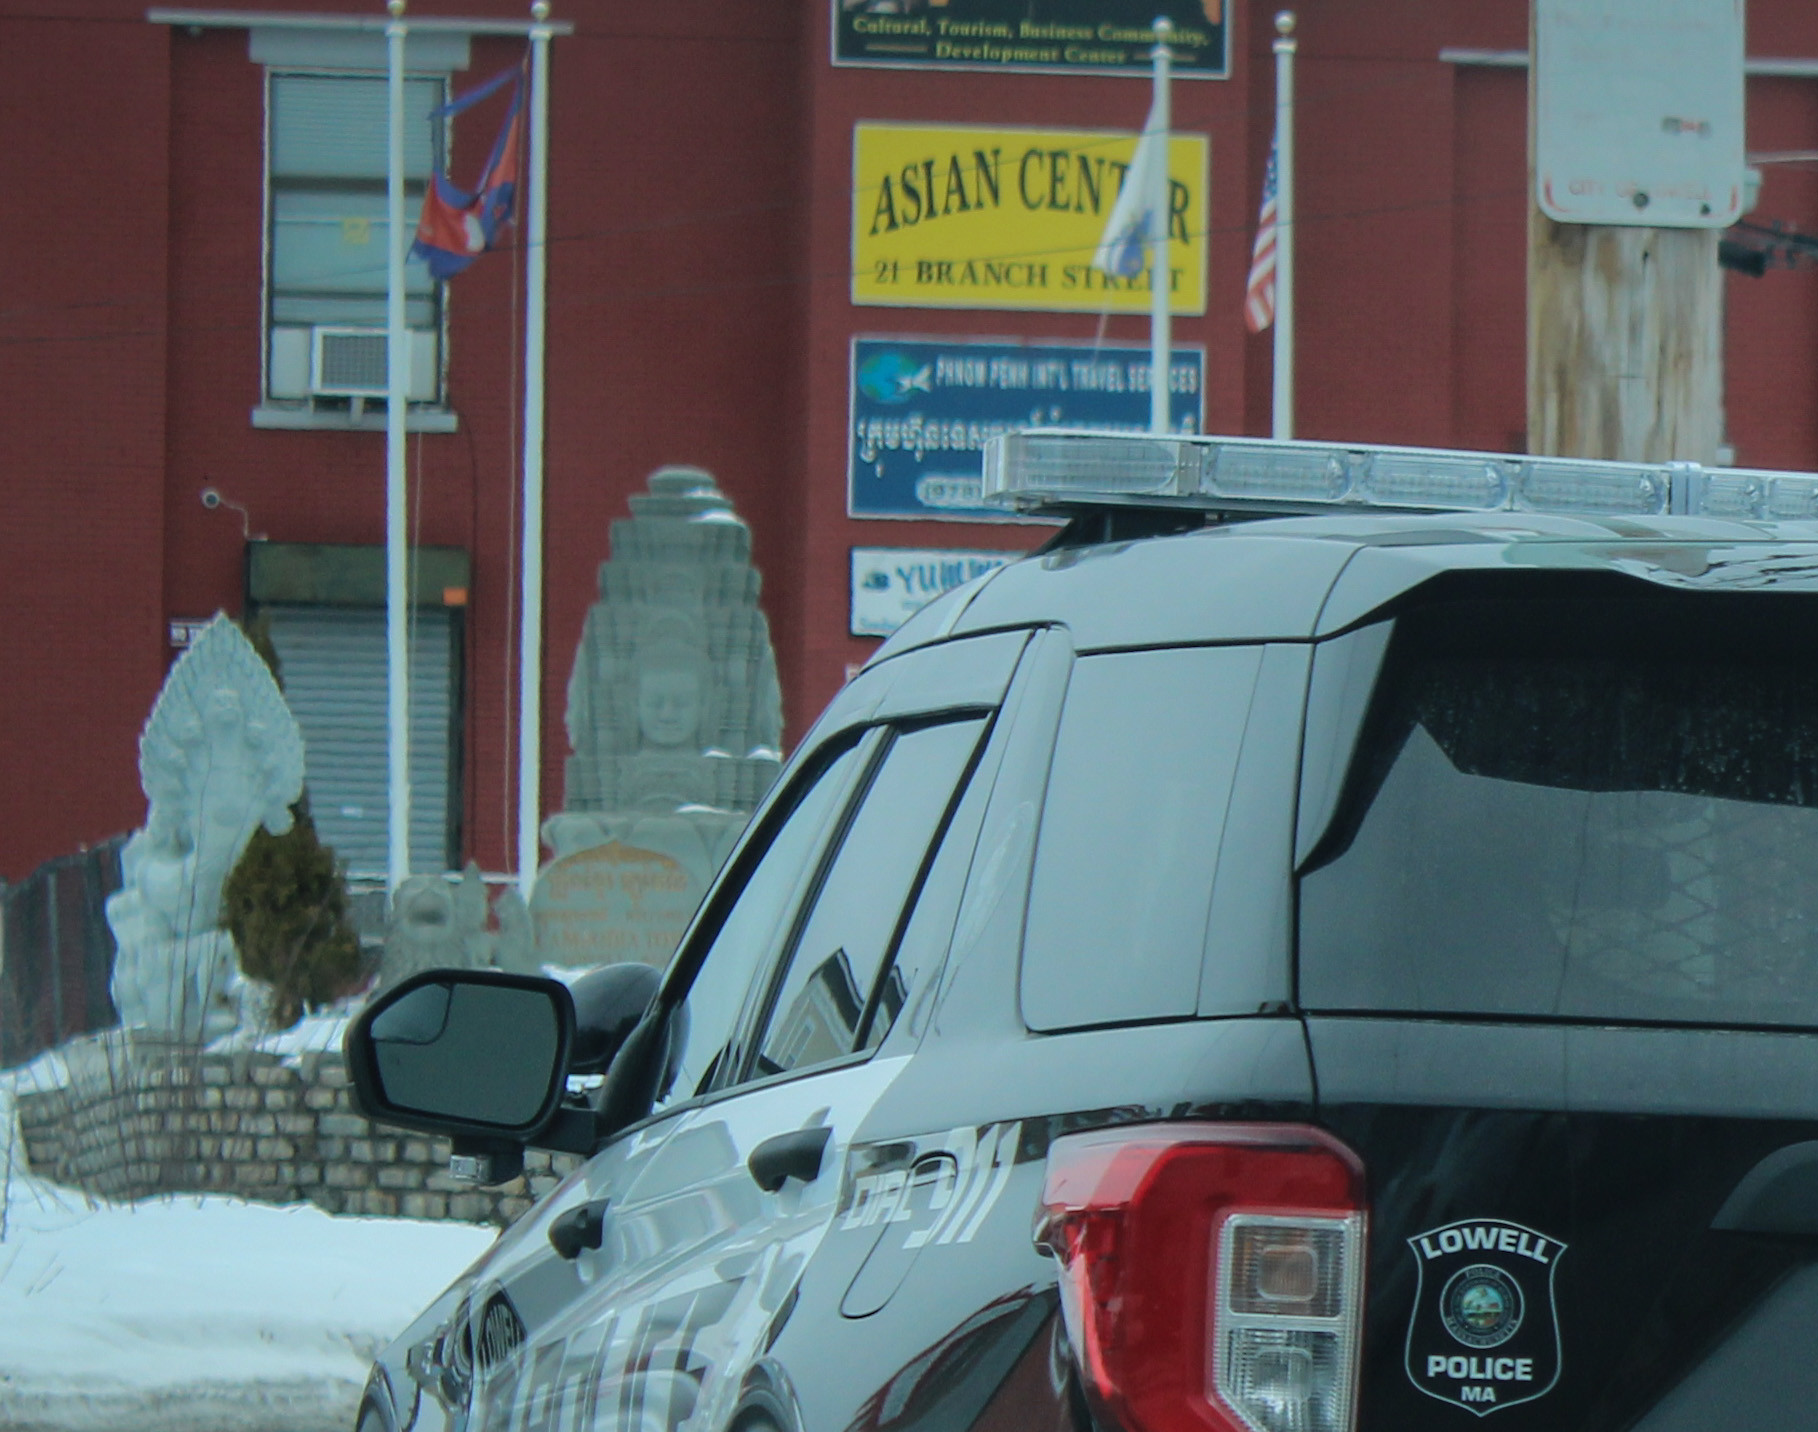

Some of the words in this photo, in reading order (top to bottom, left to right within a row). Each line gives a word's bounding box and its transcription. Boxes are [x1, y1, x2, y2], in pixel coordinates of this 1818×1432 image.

[852, 16, 931, 37] Cultural,
[937, 19, 1013, 40] Tourism,
[1019, 20, 1094, 41] Business
[935, 41, 1060, 64] Development
[1064, 46, 1127, 64] Center
[868, 147, 1003, 237] ASIAN
[1018, 147, 1191, 246] CENTR
[874, 259, 899, 285] 21
[915, 258, 1049, 289] BRANCH
[936, 354, 986, 388] PHNOM
[990, 356, 1028, 390] PENH
[1033, 359, 1068, 391] INT'L
[1072, 360, 1125, 393] TRAVEL
[1419, 1226, 1550, 1265] LOWELL
[1426, 1354, 1534, 1382] POLICE
[1460, 1385, 1497, 1402] MA
